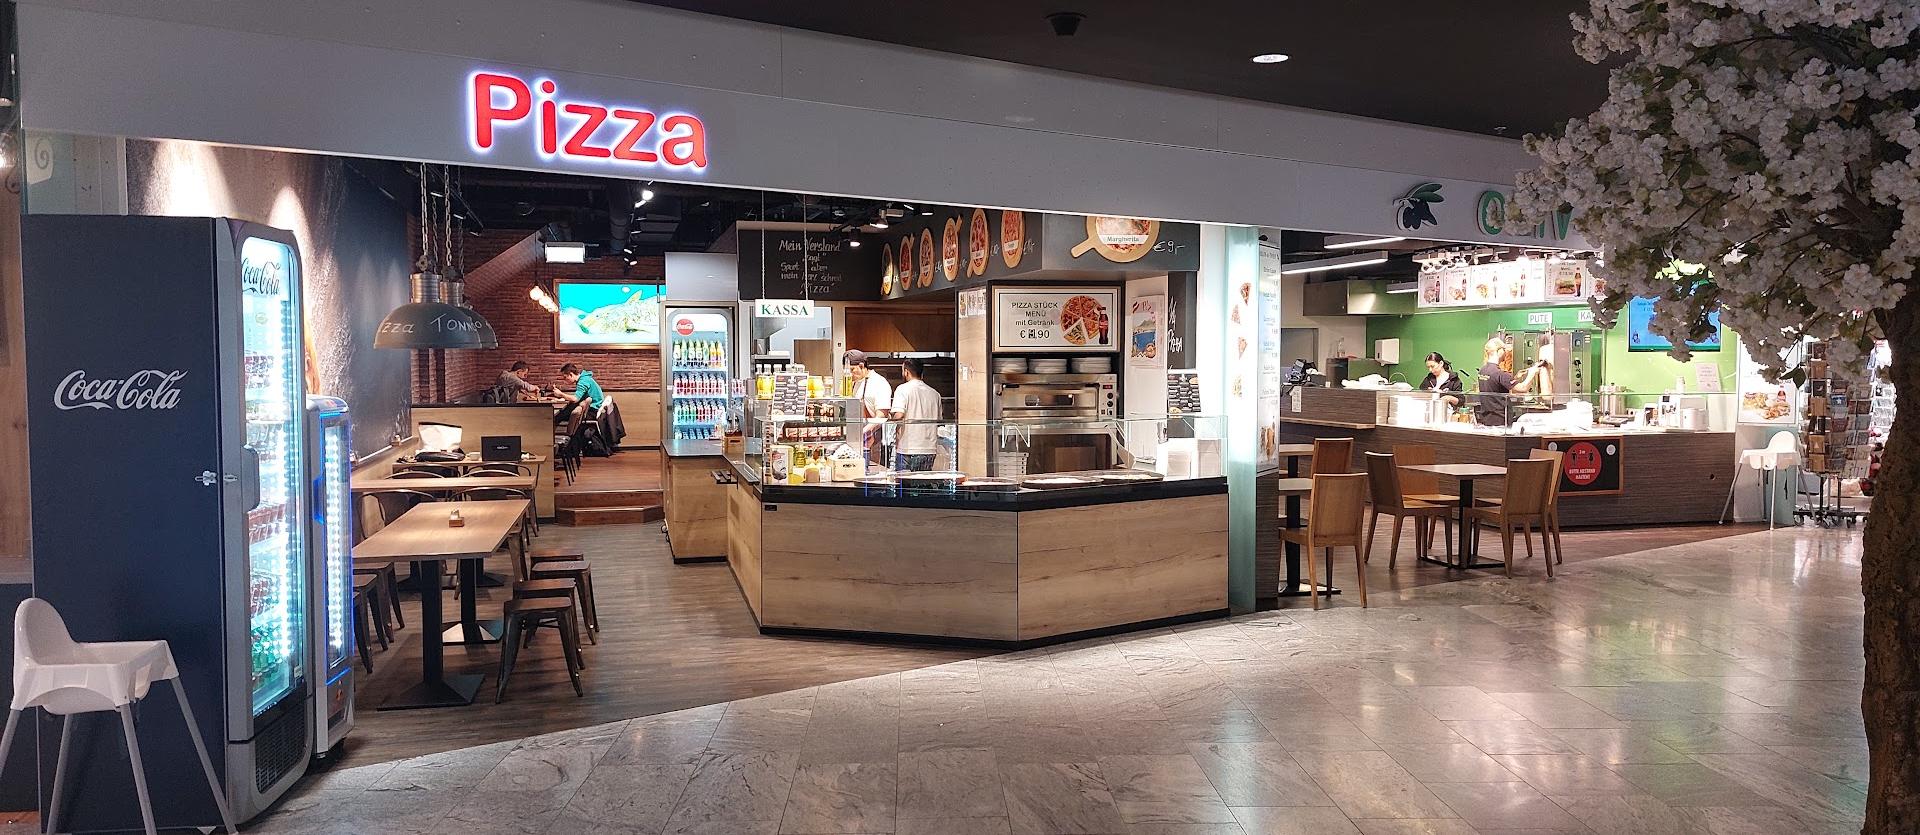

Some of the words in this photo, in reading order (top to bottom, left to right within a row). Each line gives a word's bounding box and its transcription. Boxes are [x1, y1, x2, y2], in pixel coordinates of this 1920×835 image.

[474, 73, 707, 168] Pizza
[779, 240, 802, 251] Mein
[761, 304, 809, 316] KASSA
[1033, 300, 1058, 309] STÜCK
[1529, 314, 1549, 323] PUTE
[53, 369, 189, 410] Coca-Cola
